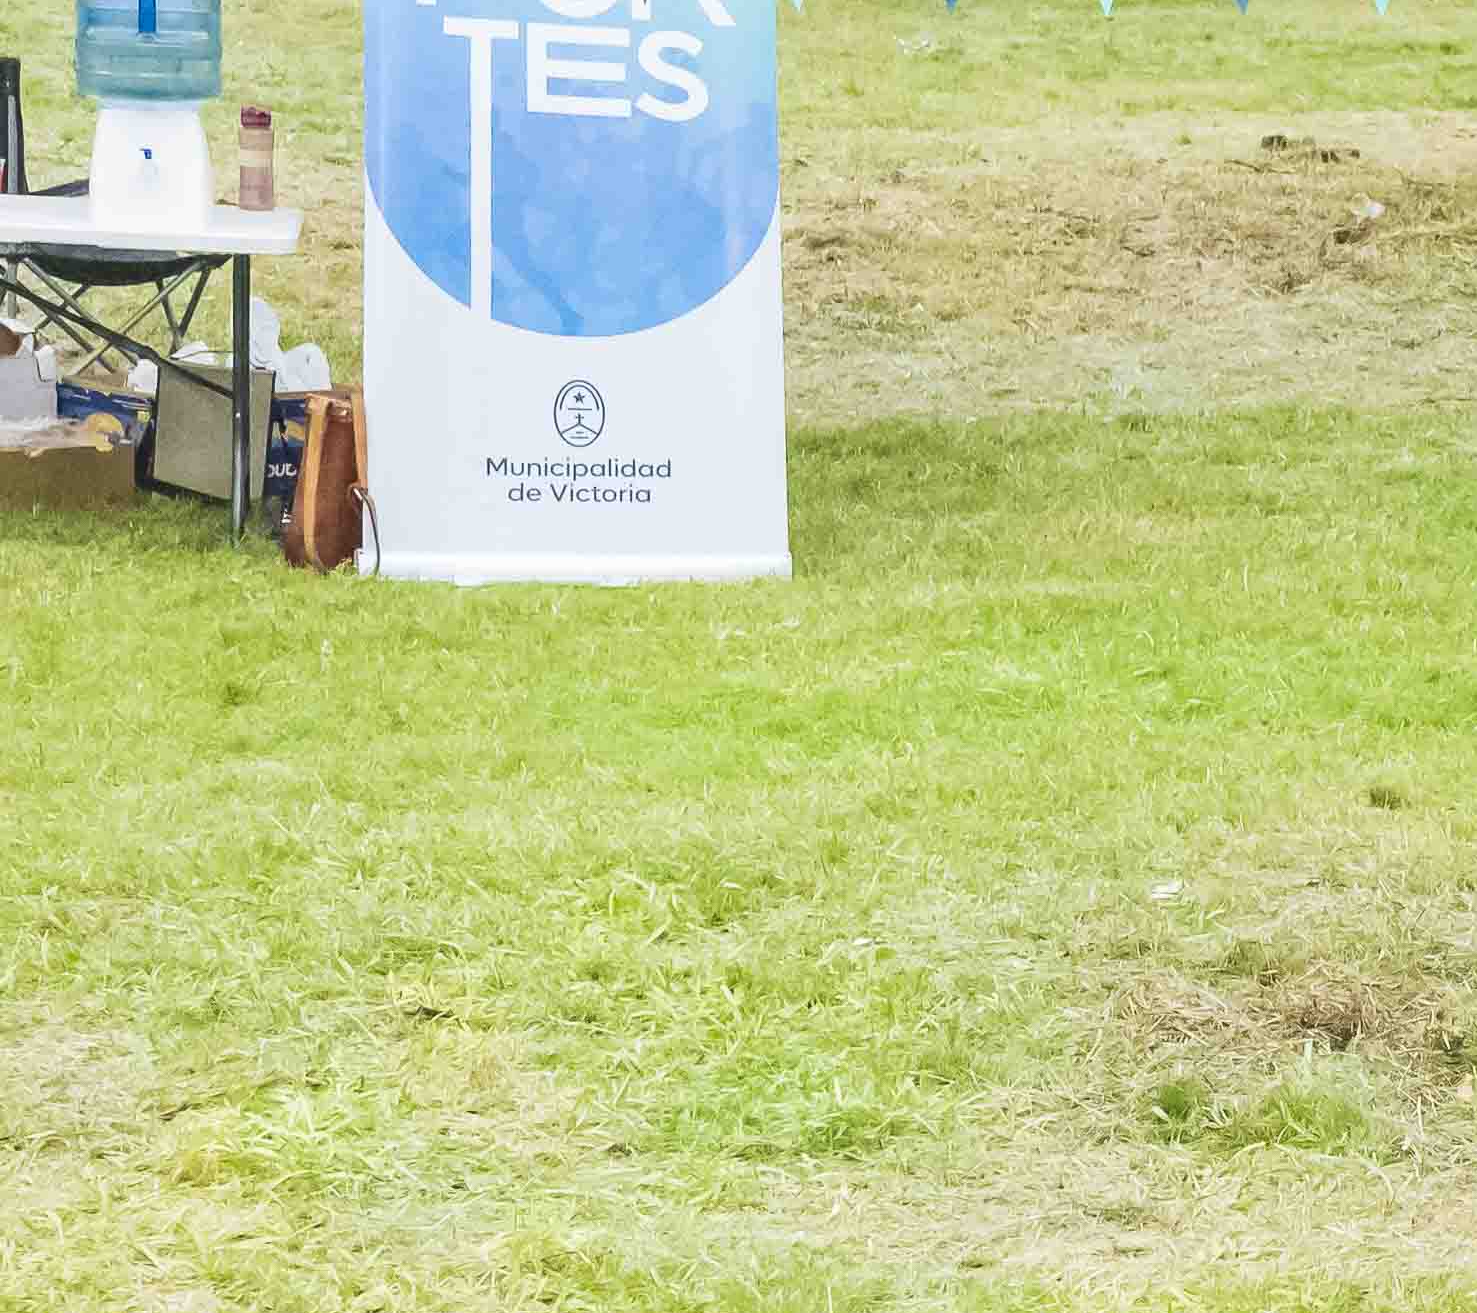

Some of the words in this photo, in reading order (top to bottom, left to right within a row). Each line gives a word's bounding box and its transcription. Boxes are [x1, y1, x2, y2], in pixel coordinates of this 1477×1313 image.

[486, 456, 673, 482] Municipalidad
[507, 482, 541, 503] de
[550, 482, 652, 504] Victoria
